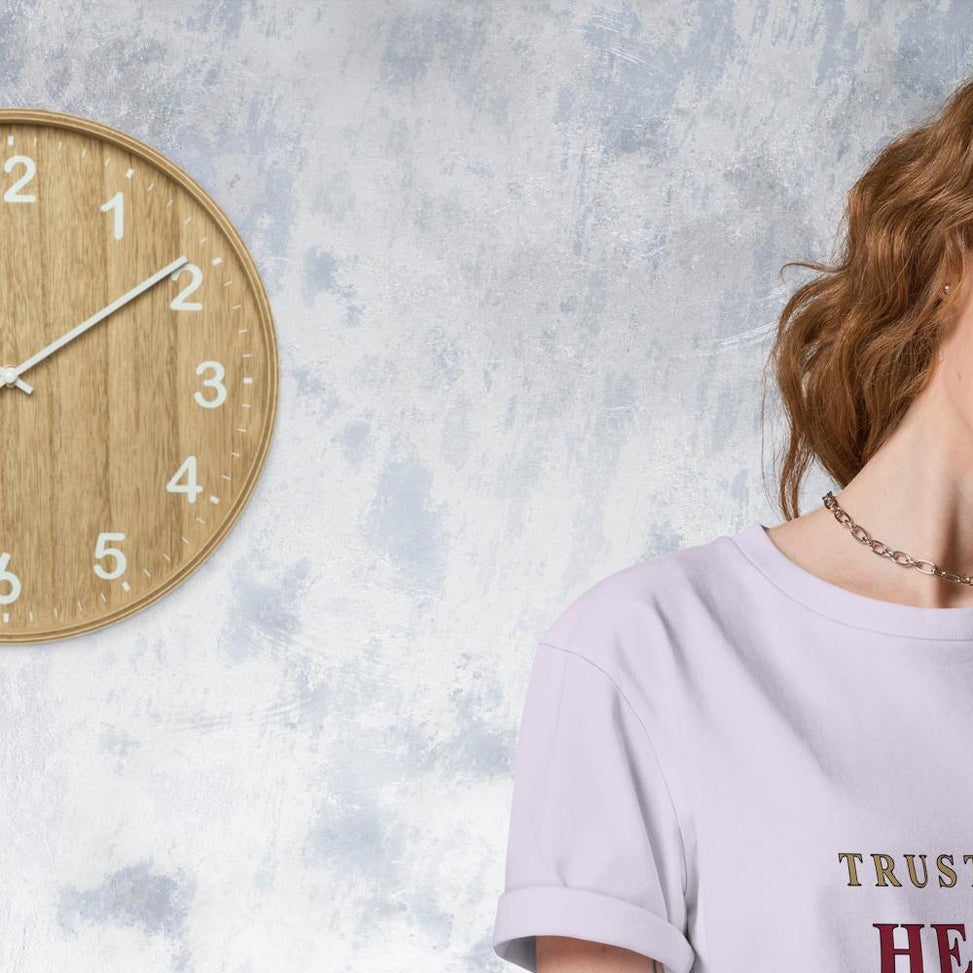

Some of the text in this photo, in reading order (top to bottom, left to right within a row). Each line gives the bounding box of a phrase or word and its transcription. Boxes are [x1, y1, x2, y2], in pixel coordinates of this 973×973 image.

[101, 191, 124, 239] 1
[170, 262, 204, 311] 2
[194, 360, 228, 409] 3
[166, 456, 203, 503] 4
[93, 532, 127, 580] 5
